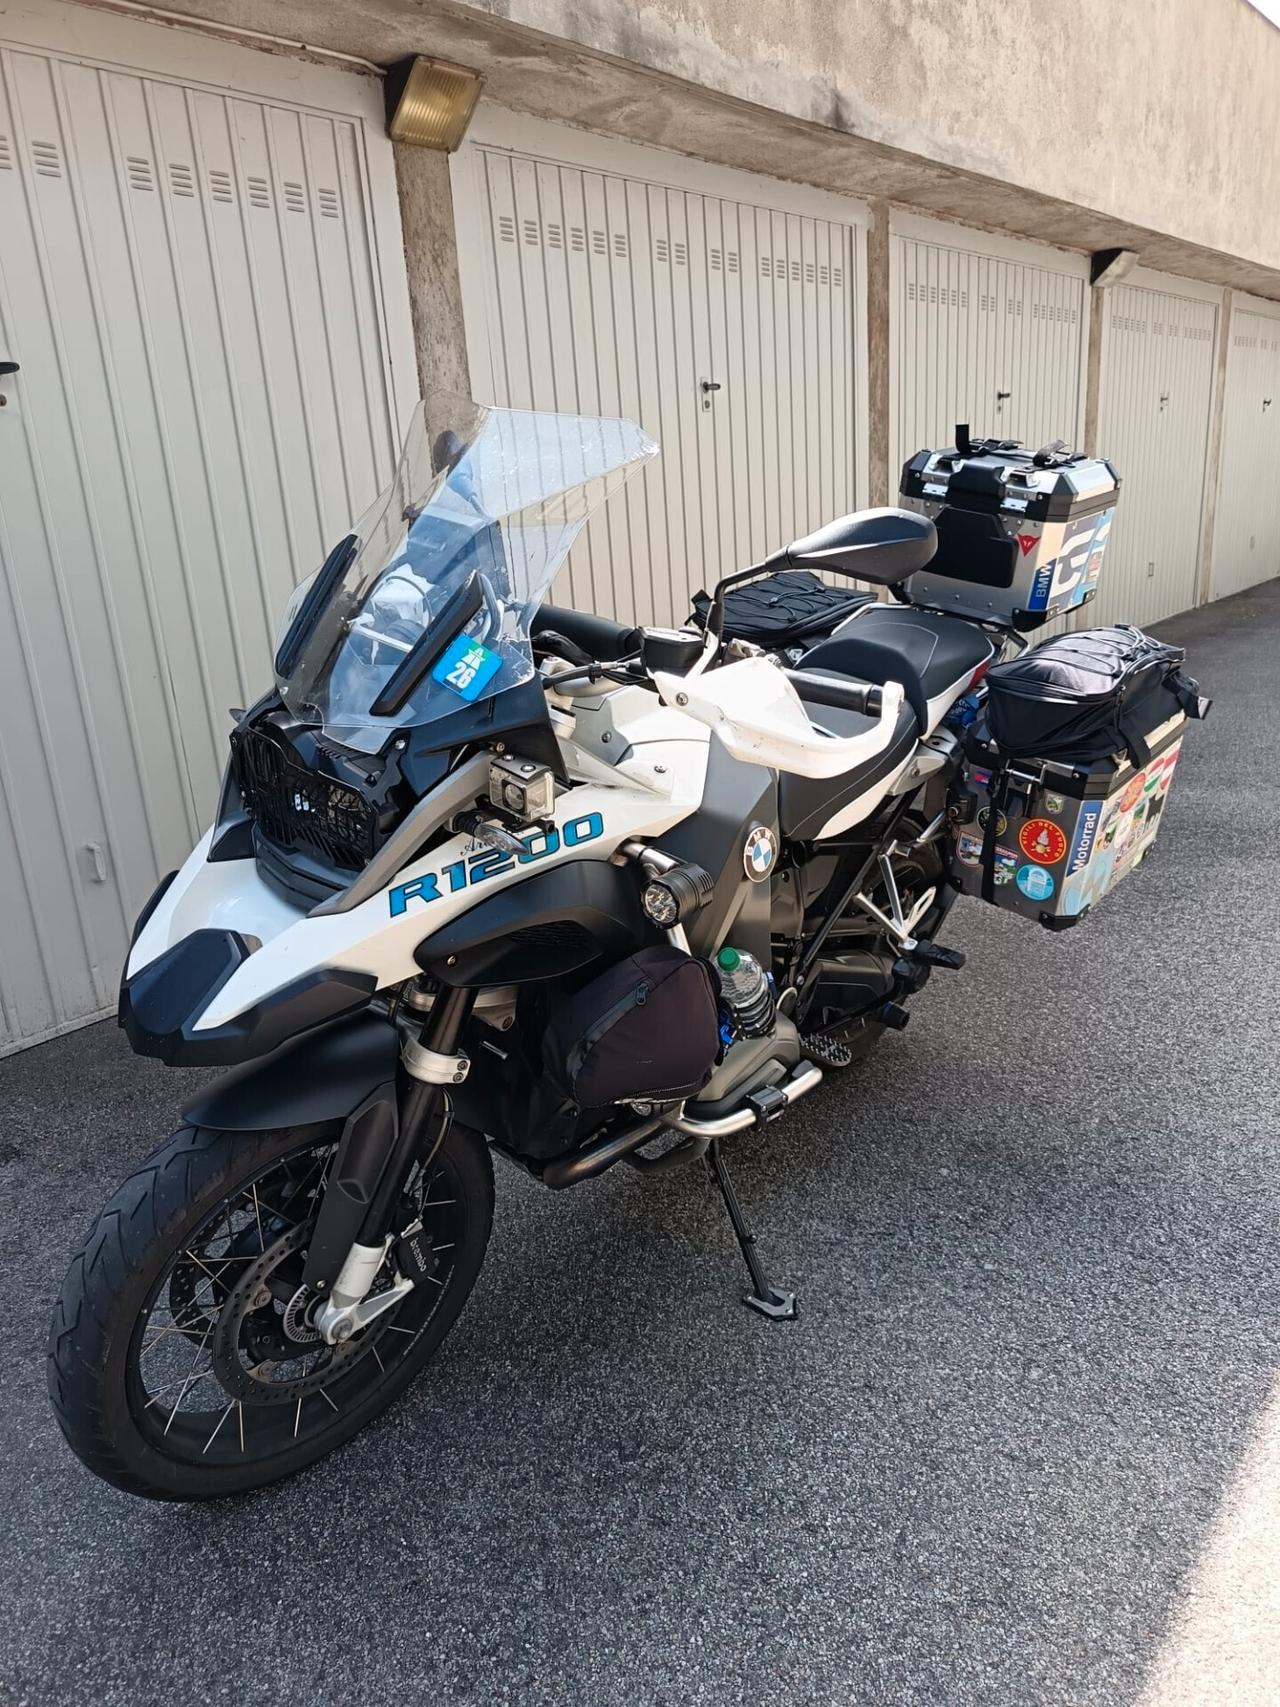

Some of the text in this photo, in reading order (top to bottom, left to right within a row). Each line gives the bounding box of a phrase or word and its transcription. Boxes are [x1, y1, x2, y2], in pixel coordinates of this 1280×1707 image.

[1035, 564, 1052, 598] BMW
[445, 661, 477, 689] 26
[746, 829, 773, 857] BMW
[1072, 812, 1097, 871] Motorrad
[388, 811, 605, 919] R1200
[410, 1236, 427, 1272] brembo
